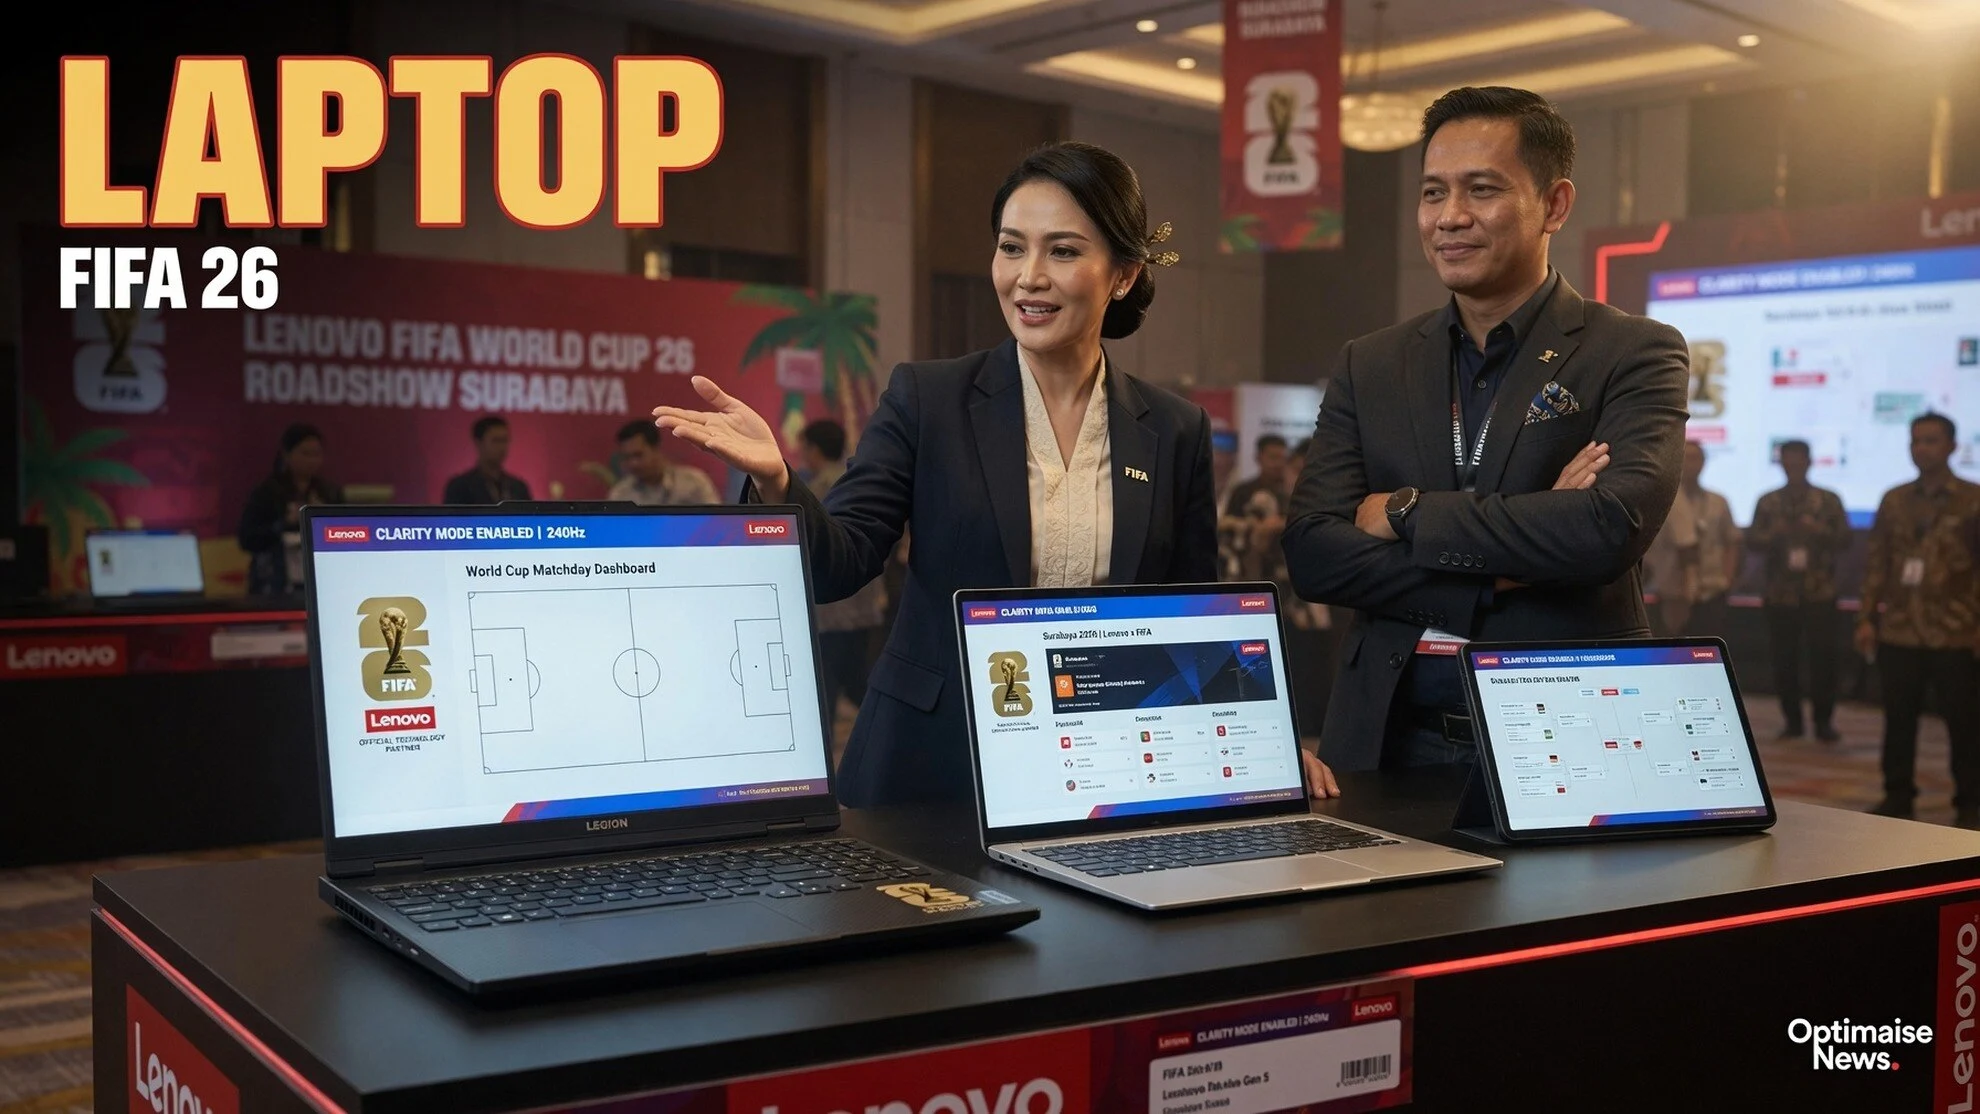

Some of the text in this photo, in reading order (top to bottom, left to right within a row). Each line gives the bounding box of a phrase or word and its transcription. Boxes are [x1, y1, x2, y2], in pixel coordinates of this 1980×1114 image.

[244, 313, 695, 374] LENOVO FIFA WORLD CUP 26
[244, 360, 629, 415] ROADSHOW SURABAYA
[1125, 467, 1149, 482] FIFA
[375, 527, 432, 541] CLARITY
[435, 527, 473, 540] MODE
[476, 527, 534, 540] ENABLED
[546, 526, 586, 539] 240Hz
[465, 561, 656, 579] World Cup Matchday Dashboard
[6, 644, 116, 670] Lenovo
[381, 678, 417, 693] FIFA
[370, 713, 432, 728] Lenovo
[1947, 922, 1978, 1114] Lenovo
[1162, 1067, 1186, 1081] FIFA
